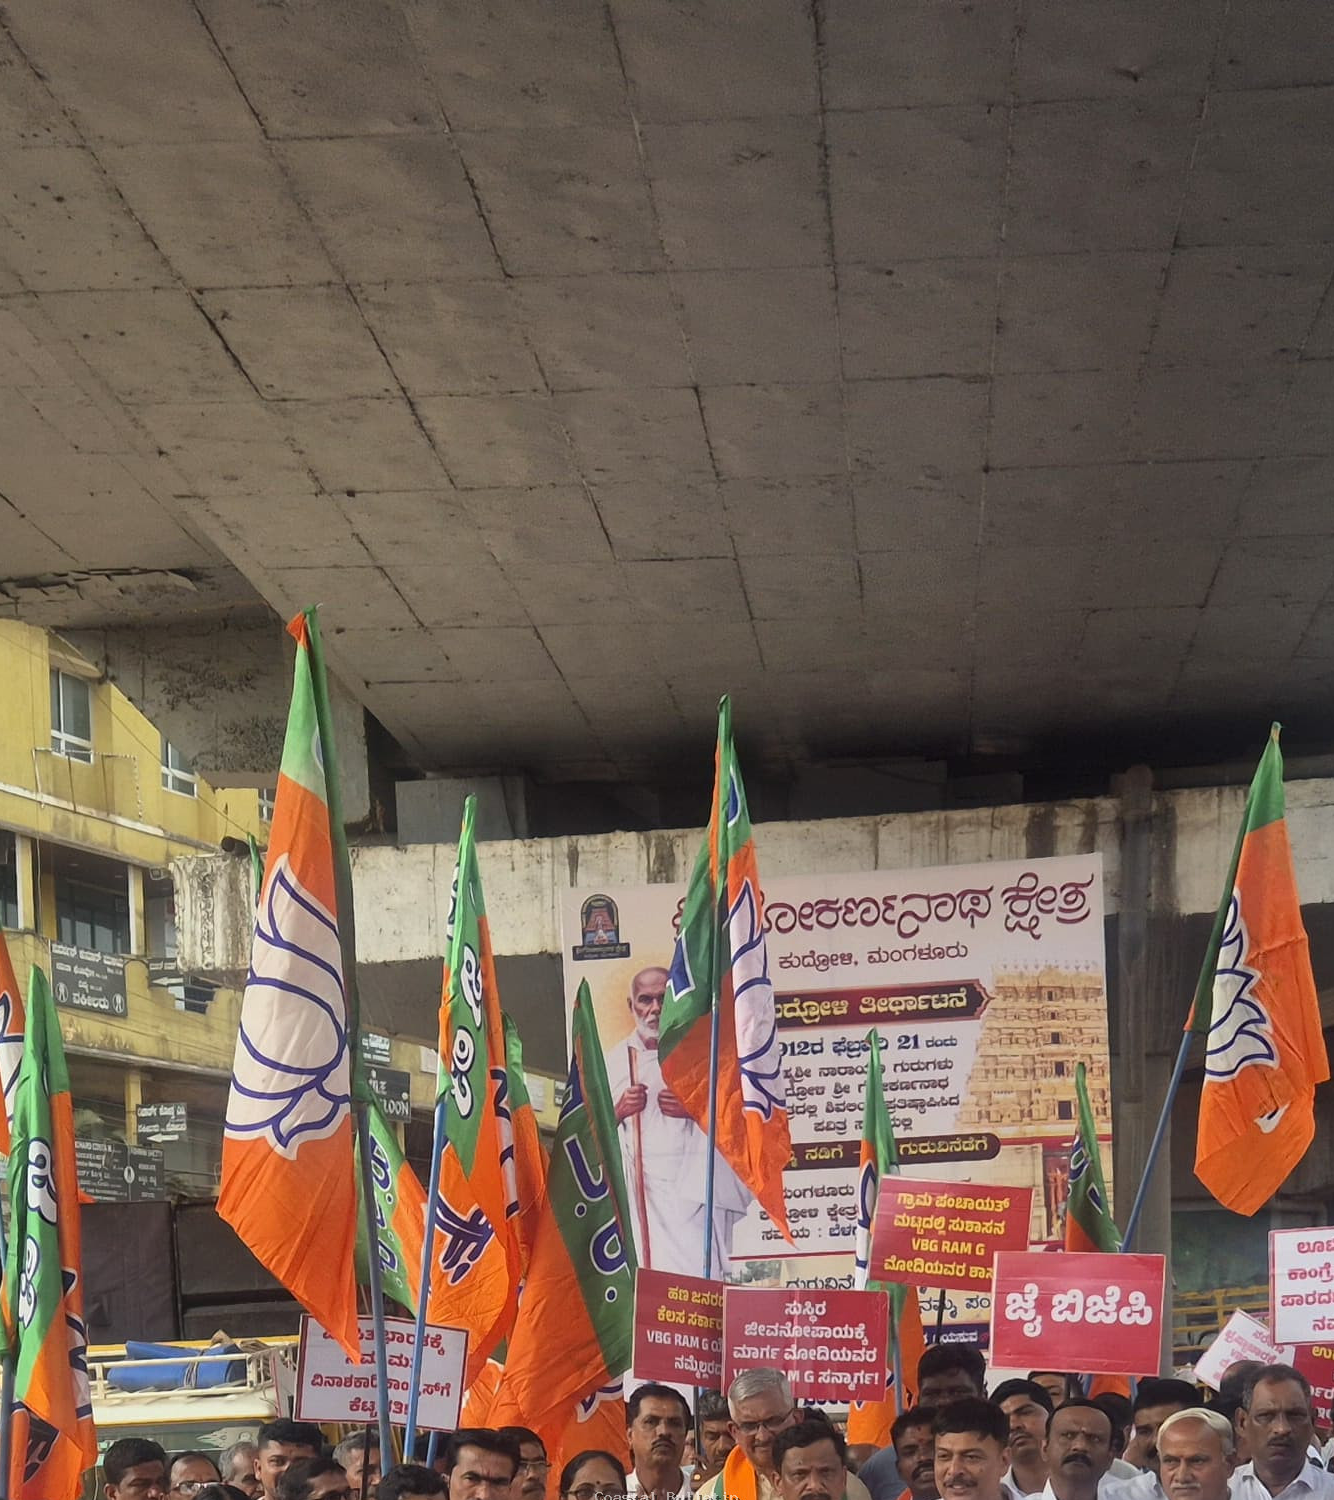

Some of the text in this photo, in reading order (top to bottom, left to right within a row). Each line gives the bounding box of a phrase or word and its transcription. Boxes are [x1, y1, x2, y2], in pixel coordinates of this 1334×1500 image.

[762, 872, 1094, 940] ೋಕರ್ಣನಾಥ ಕ್ಷೇತ್ರ
[778, 942, 968, 972] ಕುದ್ರೋಳಿ, ಮಂಗಳೂರು
[859, 988, 968, 1015] ತೀರ್ಥಾಟನೆ
[897, 1034, 958, 1050] 21 ರಂದು
[893, 1058, 954, 1073] ಗುರುಗಳು
[805, 1136, 988, 1160] ನಡಿಗೆ ಗುರುವಿನೆಡೆಗೆ
[898, 1192, 1010, 1212] ಗ್ರಾಮ ಪಂಚಾಯತ್
[948, 1218, 1005, 1235] ಸುಶಾಸನ
[911, 1238, 985, 1256] VBG RAM G
[884, 1257, 965, 1278] ಮೋದಿಯವರ
[668, 1286, 690, 1301] ಹಣ
[657, 1307, 685, 1324] ಕೆಲಸ
[785, 1301, 826, 1323] ಸುಸ್ಥಿರ
[1005, 1282, 1153, 1337] ಜೈ ಬಿಜೆಪಿ
[647, 1330, 709, 1350] VBG RAM G
[744, 1323, 869, 1346] ಜೀವನೋಪಾಯಕ್ಕೆ
[733, 1344, 877, 1362] ಮಾರ್ಗ ಮೋದಿಯವರ
[805, 1371, 814, 1384] G
